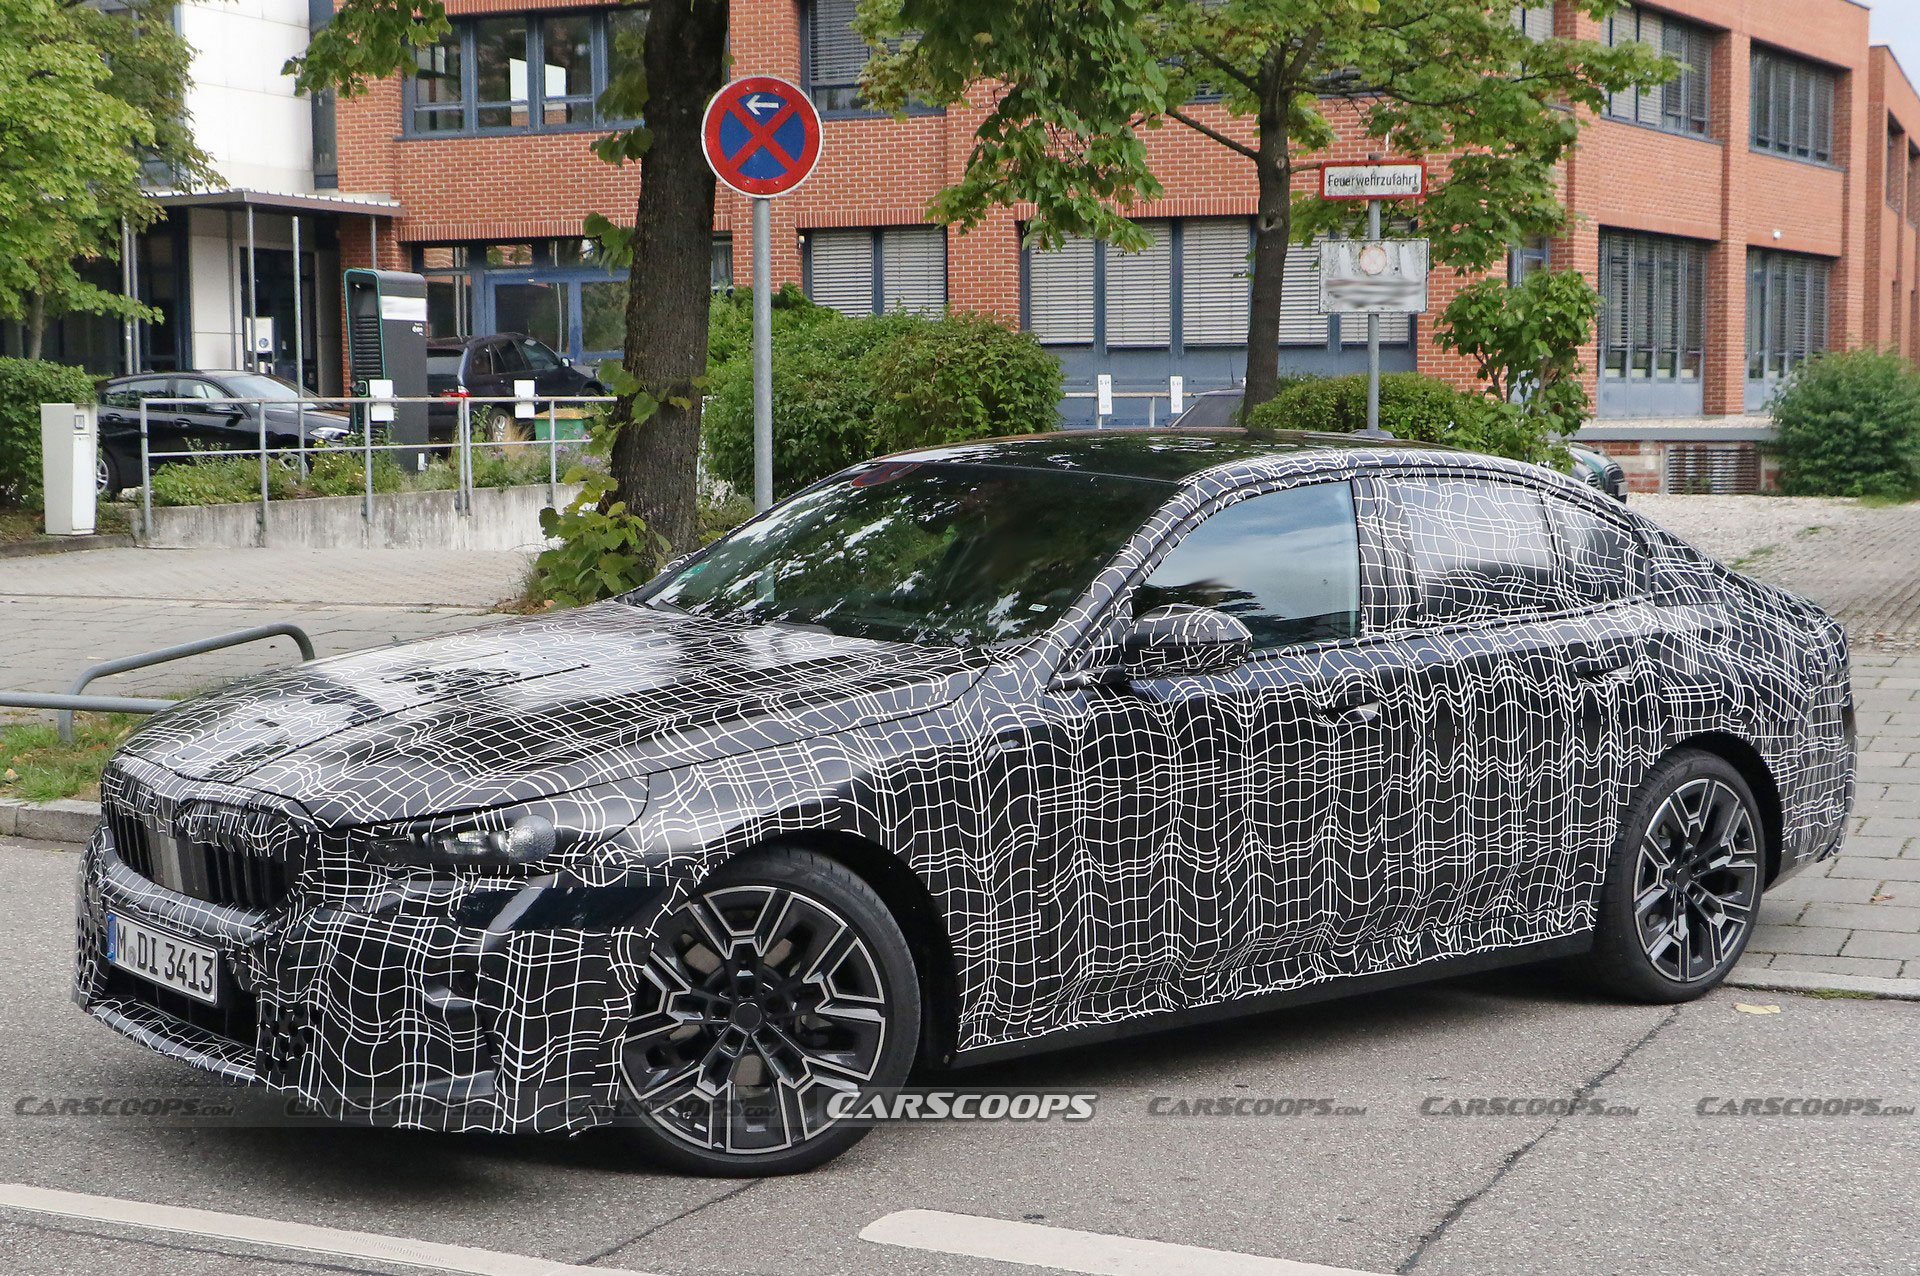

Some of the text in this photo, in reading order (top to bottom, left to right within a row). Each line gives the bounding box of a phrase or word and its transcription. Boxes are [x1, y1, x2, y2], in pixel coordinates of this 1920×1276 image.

[1327, 173, 1418, 187] Feuerwehrzufahrt
[116, 923, 214, 995] M DI 3413
